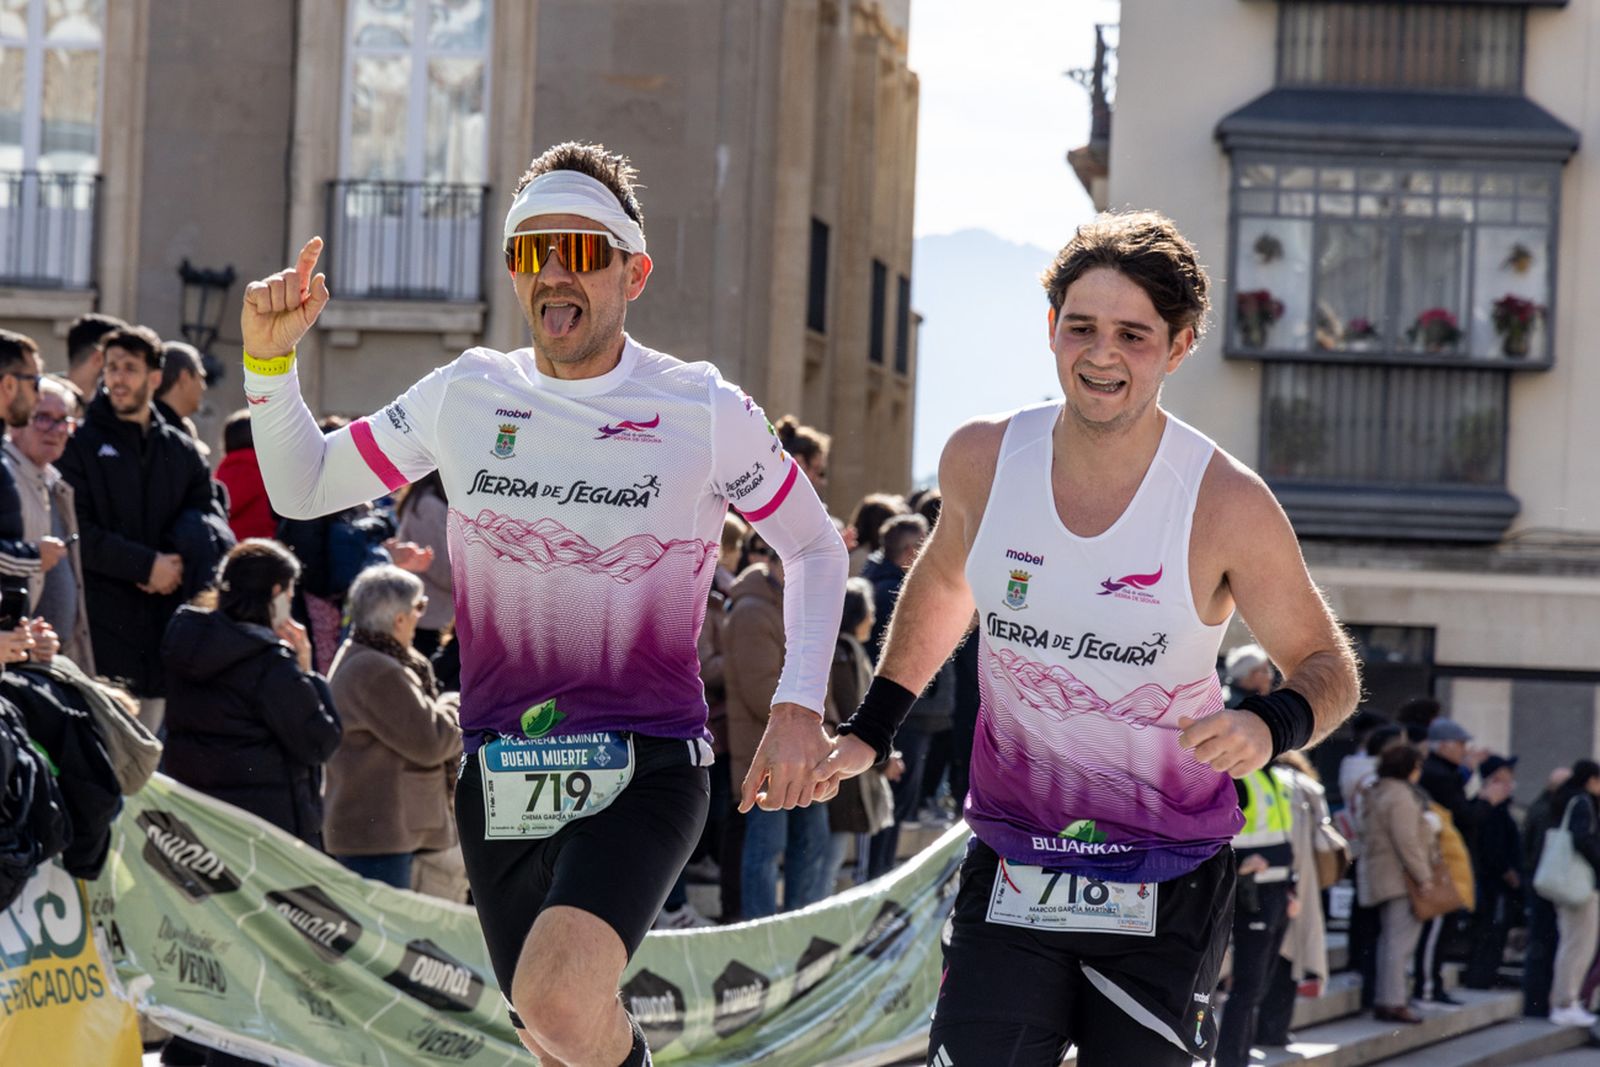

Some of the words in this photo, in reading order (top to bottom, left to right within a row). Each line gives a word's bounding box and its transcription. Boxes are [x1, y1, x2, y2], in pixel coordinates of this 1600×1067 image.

[495, 407, 532, 420] mobel
[467, 469, 537, 499] SIERRA
[541, 486, 563, 498] DE
[557, 480, 650, 508] SEGURA
[736, 474, 764, 500] SEGURA
[1005, 548, 1044, 566] mobel
[987, 612, 1048, 649] SIERRA
[1051, 634, 1073, 651] DE
[1068, 632, 1157, 666] SEGURA
[501, 750, 540, 767] BUENA
[543, 749, 588, 766] MUERTE
[559, 733, 611, 744] CAMINATA
[524, 771, 592, 812] 719
[1038, 866, 1110, 906] 718
[278, 902, 348, 948] ownat
[409, 954, 472, 997] ownat
